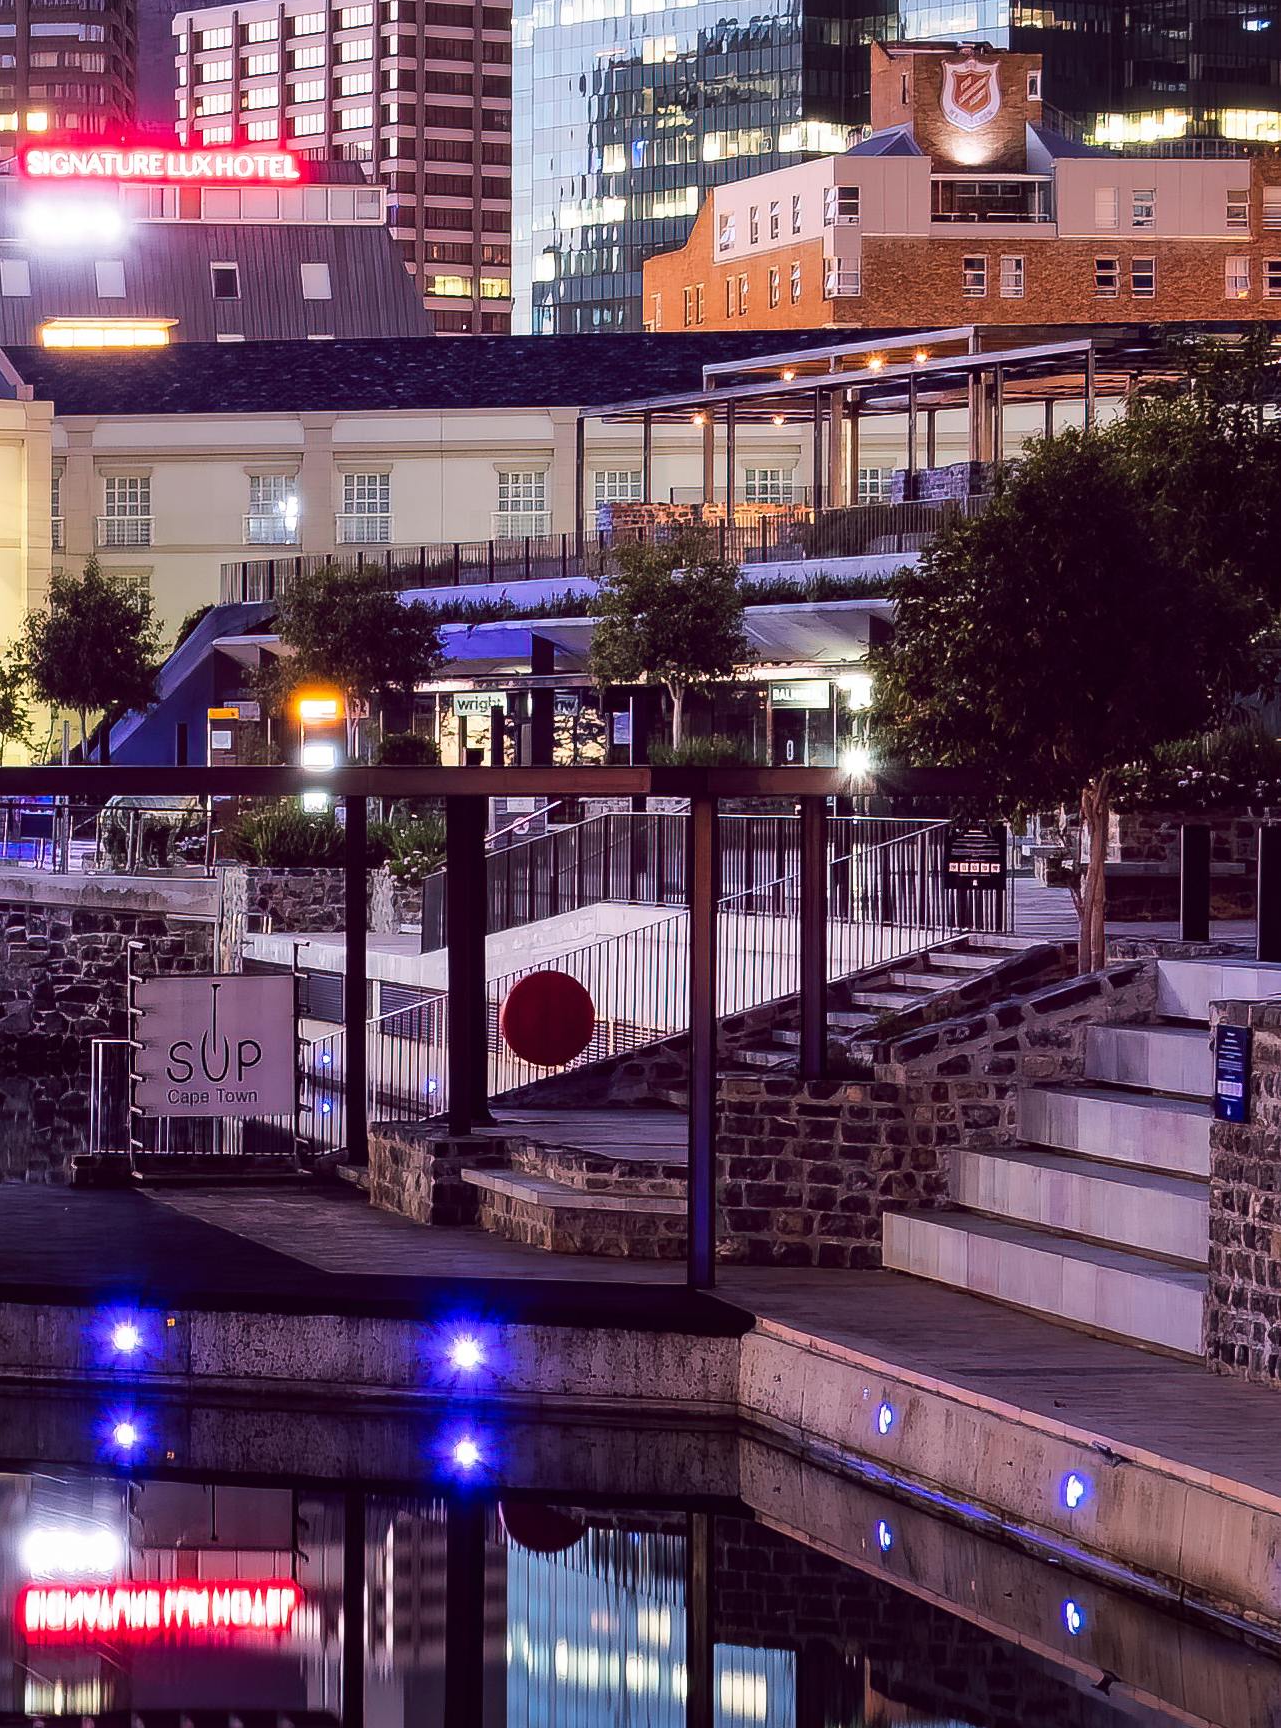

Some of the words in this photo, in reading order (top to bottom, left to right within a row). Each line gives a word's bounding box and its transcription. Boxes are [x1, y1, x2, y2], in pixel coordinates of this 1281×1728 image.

[26, 150, 164, 177] SIGNATURE
[167, 153, 213, 177] LUX
[215, 155, 301, 178] HOTEL
[166, 1029, 262, 1084] SUP
[167, 1089, 210, 1106] Cape
[216, 1088, 258, 1103] Town
